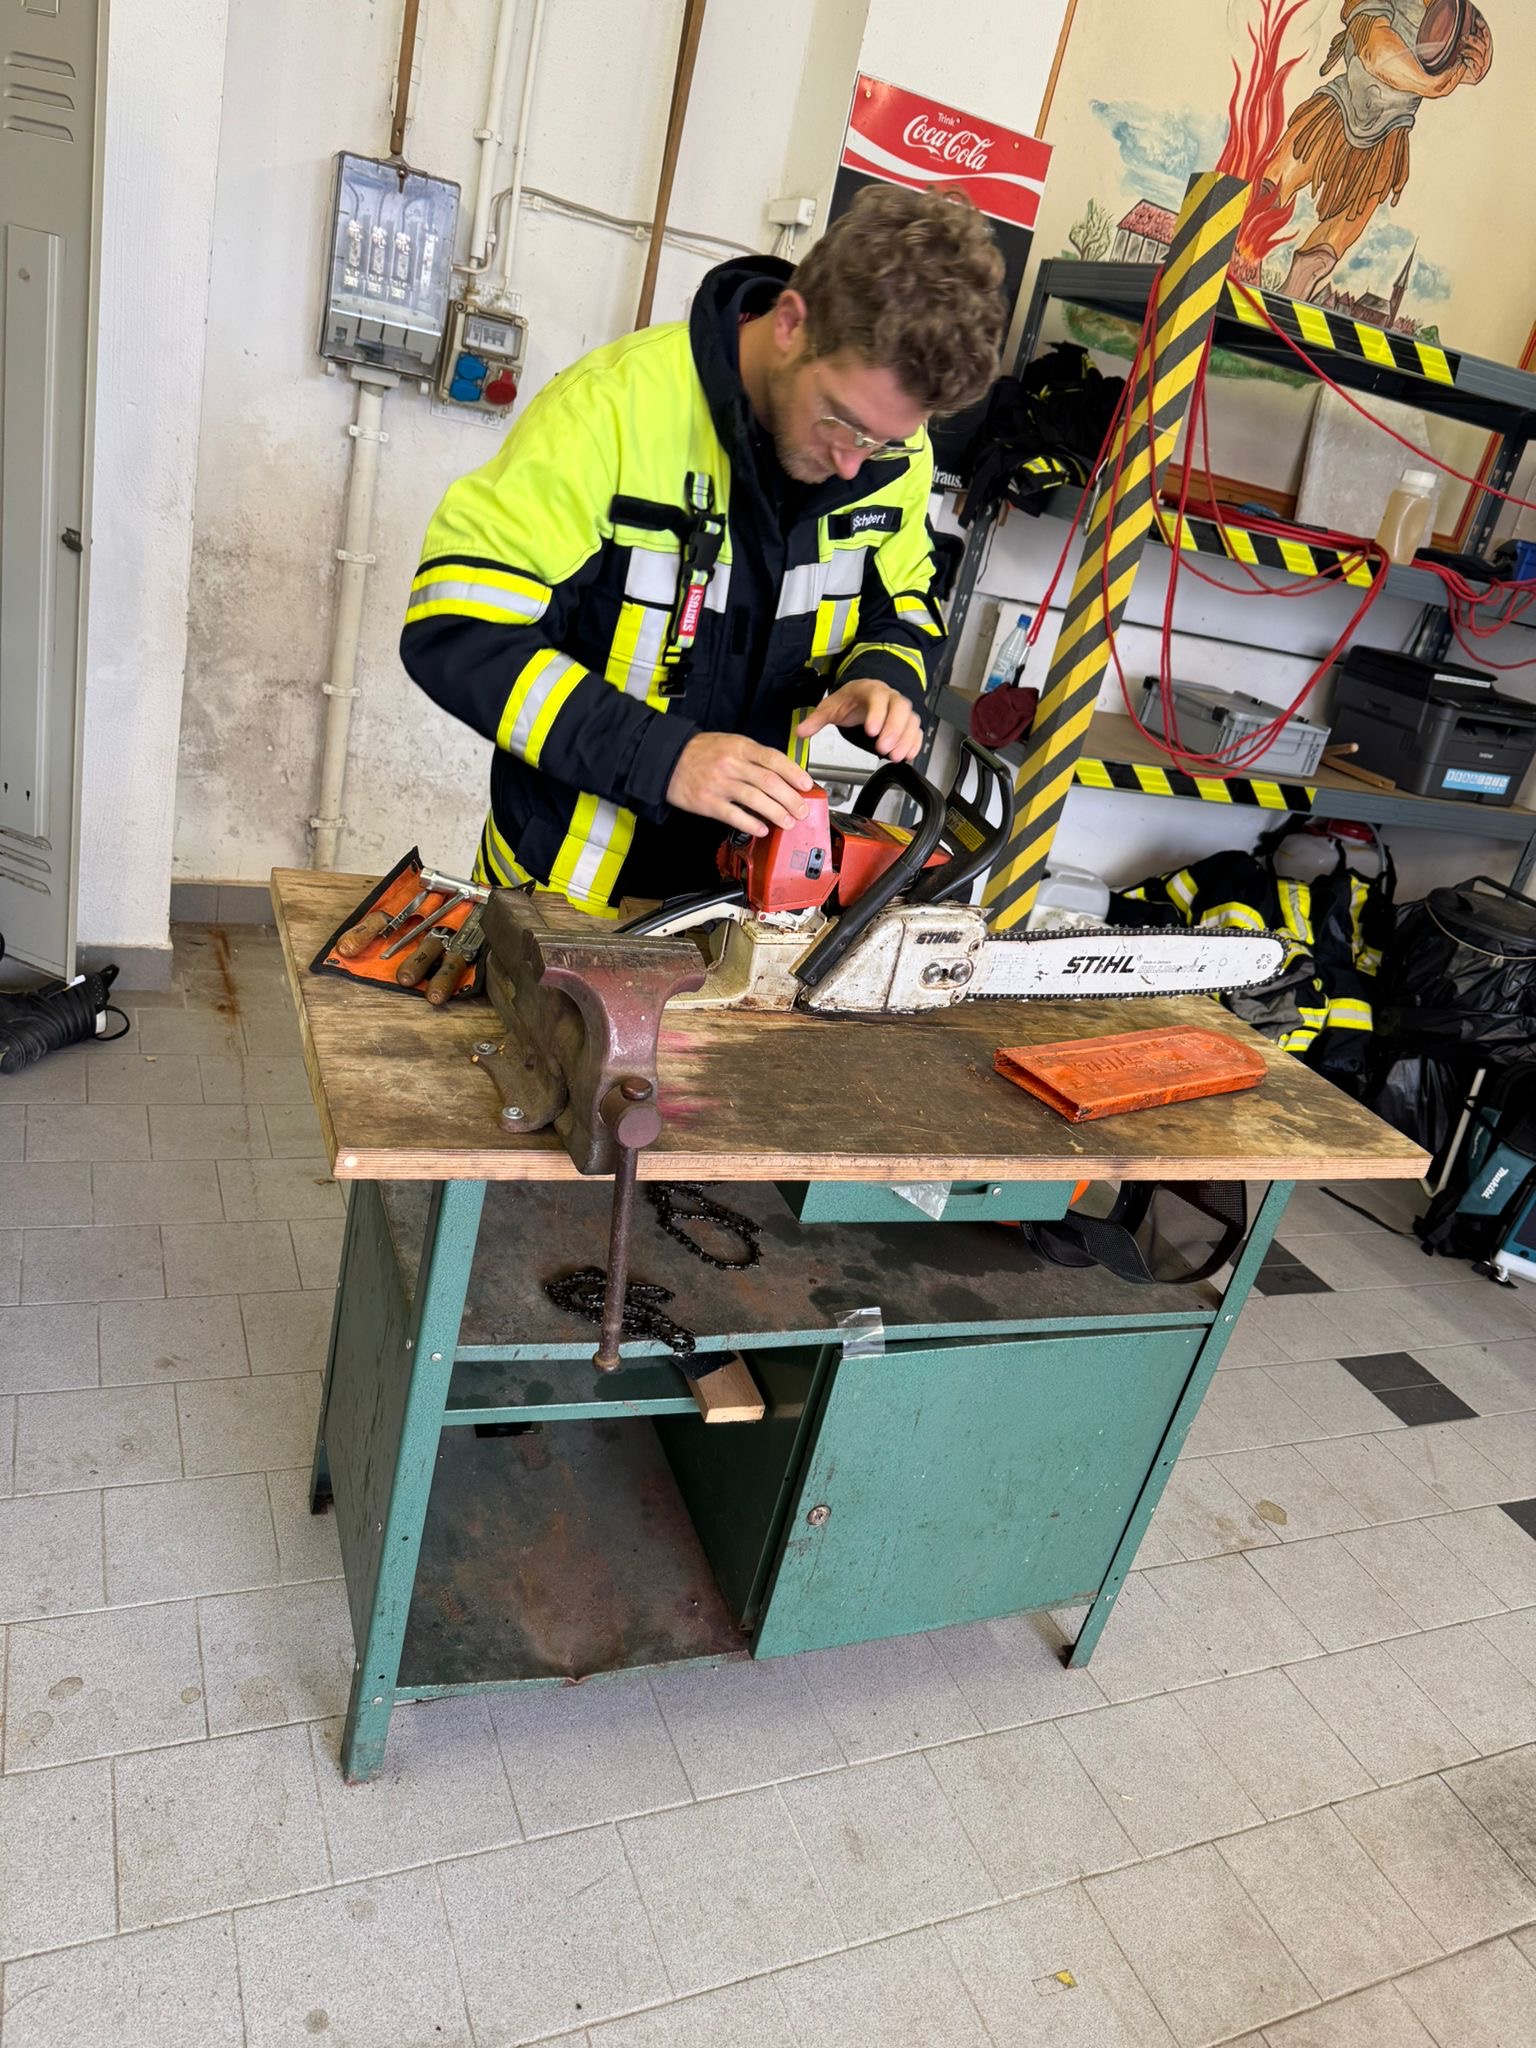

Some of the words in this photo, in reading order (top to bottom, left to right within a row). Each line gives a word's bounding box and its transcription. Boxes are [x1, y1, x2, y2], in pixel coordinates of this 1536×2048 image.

[938, 112, 955, 126] Trink
[903, 114, 995, 170] Coca-Cola
[916, 931, 961, 944] STIHL
[1061, 955, 1135, 974] STIHL
